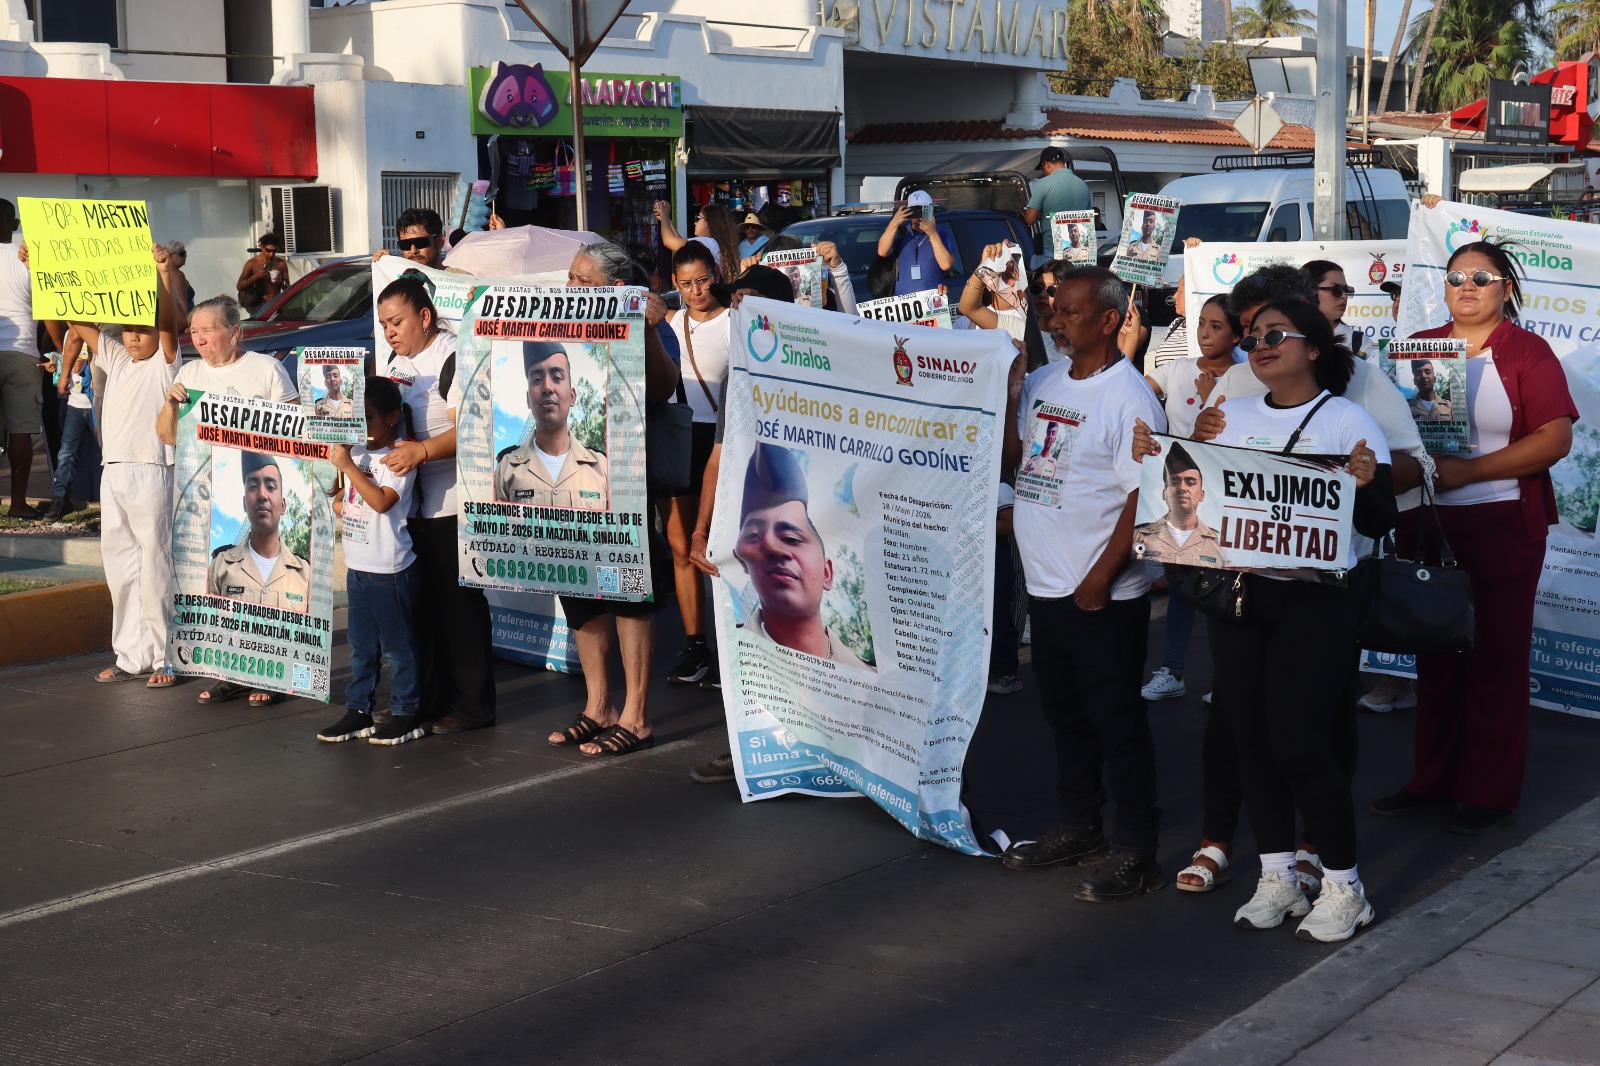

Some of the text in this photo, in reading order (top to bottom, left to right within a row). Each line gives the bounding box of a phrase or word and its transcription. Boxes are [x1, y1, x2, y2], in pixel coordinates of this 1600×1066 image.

[875, 0, 1072, 59] VISTAMAR
[566, 78, 681, 107] MAPACHE
[1552, 89, 1573, 103] ATE
[582, 113, 613, 126] ouvenirs
[42, 202, 148, 229] POR MARTIN
[1496, 225, 1564, 240] Comisión Estatal de
[32, 234, 151, 266] Y POR TODAS LAS
[1531, 238, 1540, 246] de
[1541, 240, 1572, 250] Personas
[85, 269, 109, 289] QUE
[481, 294, 618, 320] DESAPARECIDO
[476, 318, 627, 340] JOSÉ MARTIN CARRILLO GODÍNEZ
[304, 350, 355, 358] DESAPARECIDO
[1389, 342, 1454, 352] DESAPARECIDO
[781, 343, 831, 371] Sinaloa
[917, 355, 977, 375] SINALOA
[919, 371, 946, 381] GOBIERNO
[752, 383, 978, 443] Ayúdanos a encontrar a
[199, 425, 220, 442] JOSÉ
[222, 429, 251, 447] MARTIN
[253, 434, 291, 454] CARRILLO
[783, 424, 836, 450] MARTIN
[840, 436, 893, 464] CARRILLO
[898, 447, 973, 474] GODÍNE
[1222, 469, 1341, 511] EXIJIMOS
[879, 491, 953, 510] Fecha de Desaparición:
[895, 505, 910, 515] Mayo
[464, 502, 642, 526] SE DESCONOCE SU PARADERO DESDE EL 18 DE
[883, 514, 949, 532] Municipio del hecho:
[1270, 504, 1292, 523] SU
[474, 520, 634, 546] MAYO DE 2026 EN MAZATLÁN, SINALOA.
[883, 538, 899, 547] Sexo:
[1219, 516, 1339, 562] LIBERTAD
[464, 538, 645, 564] ¡AYÚDALO A REGRESAR A CASA!
[883, 549, 900, 559] Edad:
[912, 554, 929, 563] años
[1550, 544, 1582, 556] Pantalón
[486, 557, 588, 585] 6693262089
[885, 572, 899, 581] Tez:
[1552, 565, 1573, 573] mano
[887, 584, 930, 597] Complexión:
[889, 595, 907, 604] Cara:
[1542, 591, 1597, 607] 2026, siendo las
[174, 594, 330, 632] SE DESCONOCE SU PARADERO DESDE EL 18 DE
[890, 606, 909, 616] Ojos:
[181, 611, 323, 648] MAYO DE 2026 EN MAZATLÁN, SINALOA.
[498, 613, 569, 635] referente a esta
[892, 617, 912, 627] Nariz:
[496, 628, 557, 650] ayuda es muy
[894, 628, 920, 640] Cabello:
[227, 637, 234, 646] A
[239, 638, 287, 658] REGRESAR
[293, 651, 300, 659] A
[304, 653, 329, 667] CASA!
[895, 640, 917, 651] Frente:
[192, 646, 285, 680] 6693262089
[1533, 649, 1550, 663] Tu
[898, 662, 917, 672] Cejas:
[749, 736, 767, 749] Si
[752, 750, 800, 765] llama
[867, 781, 912, 813] referente
